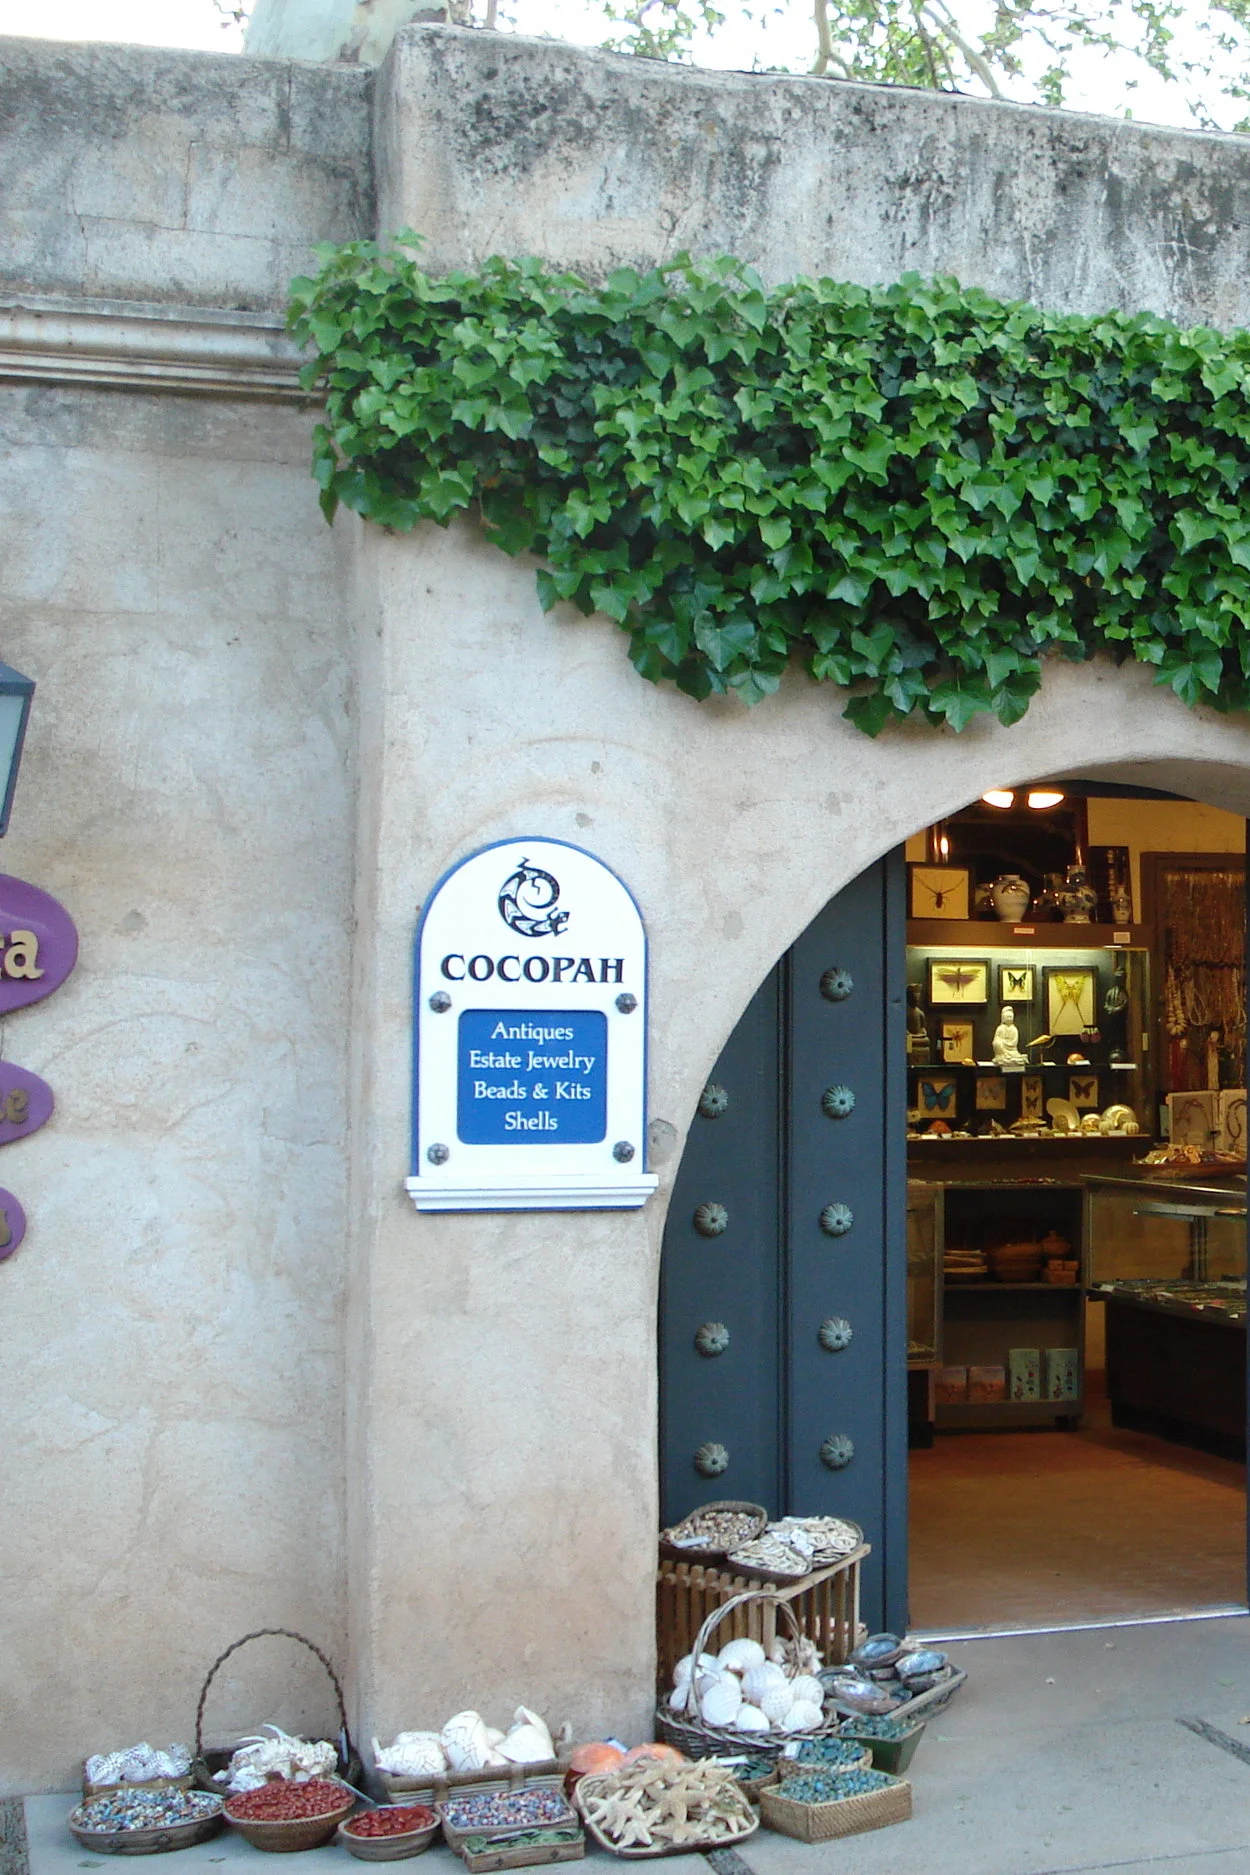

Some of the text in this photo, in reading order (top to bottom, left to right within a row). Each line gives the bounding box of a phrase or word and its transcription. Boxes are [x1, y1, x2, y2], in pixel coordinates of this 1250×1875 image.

[440, 953, 625, 984] COCOPAH
[490, 1021, 574, 1046] Antiques
[469, 1049, 596, 1074] Estate Jewelry
[474, 1080, 592, 1100] Beads & Kits
[504, 1110, 559, 1131] Shells
